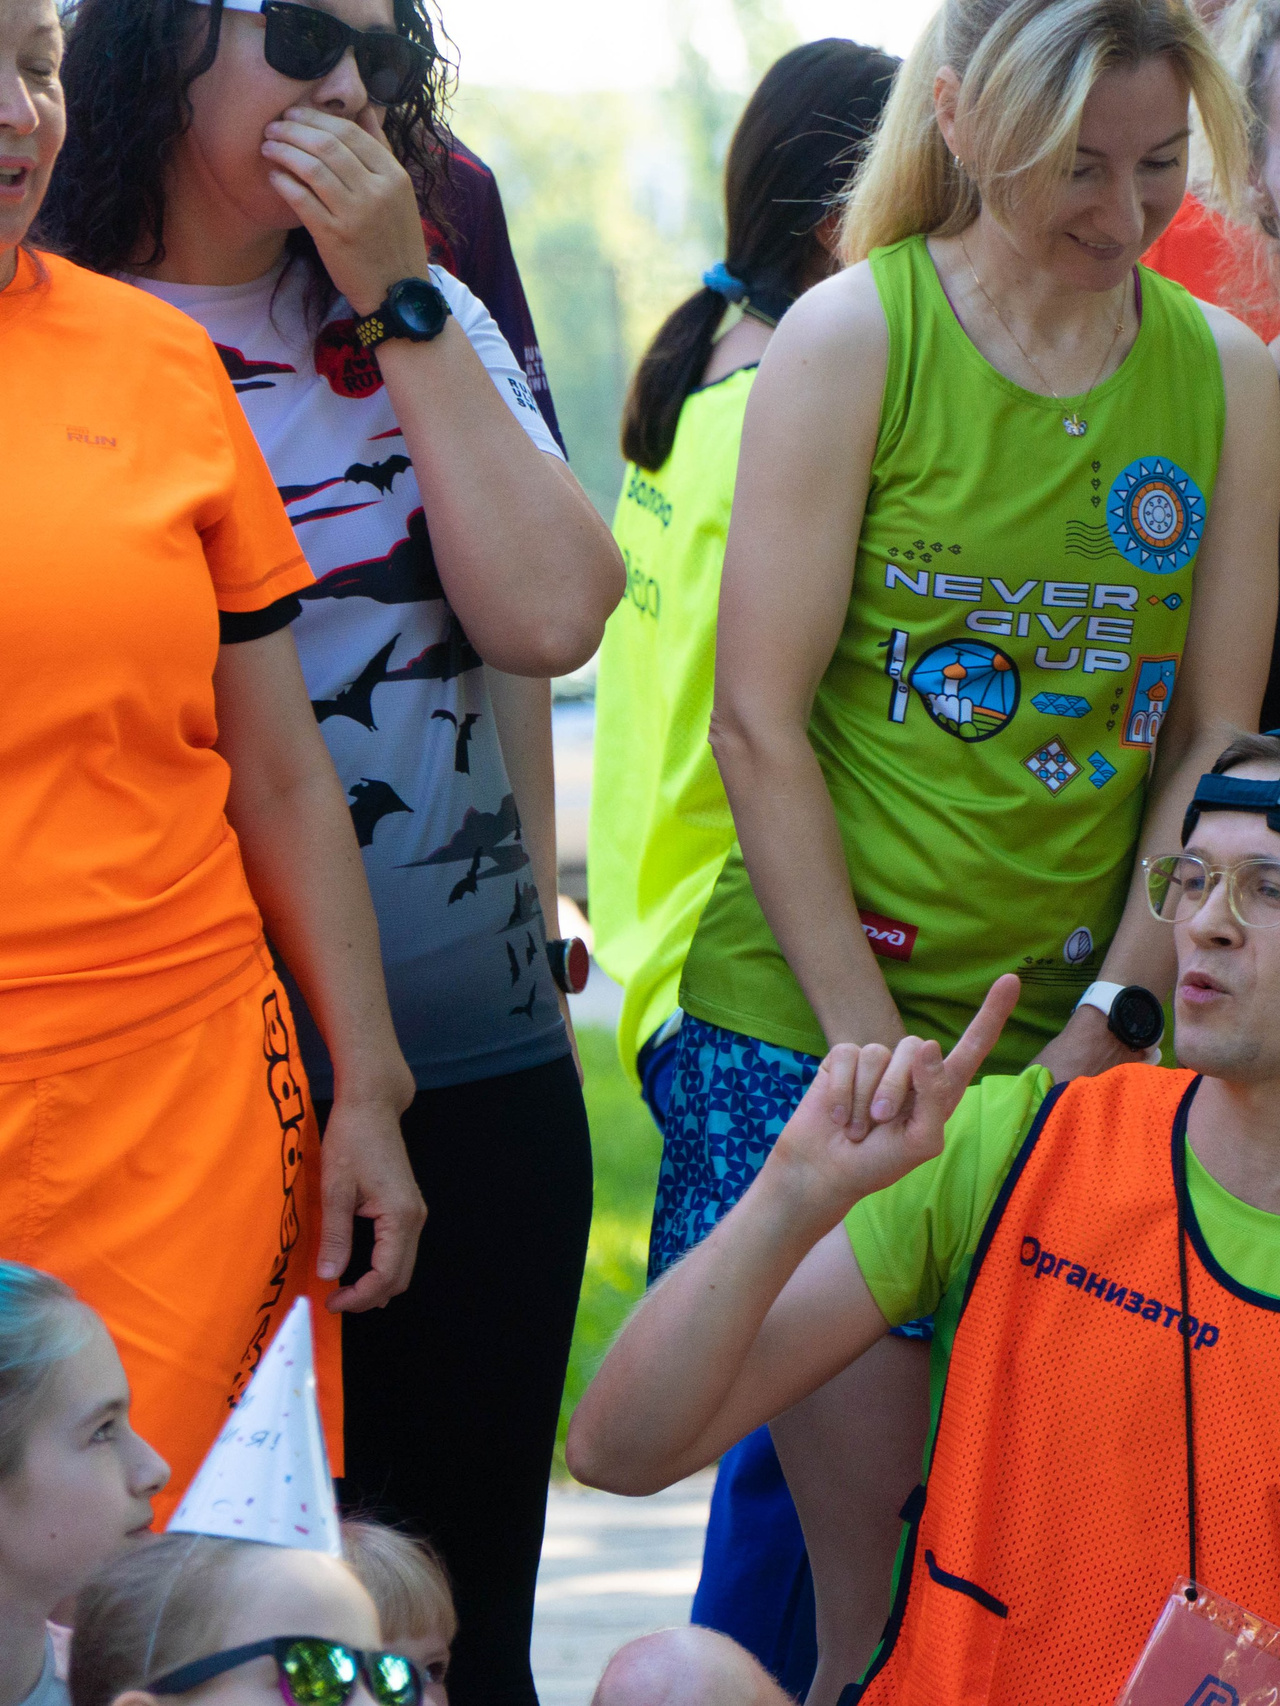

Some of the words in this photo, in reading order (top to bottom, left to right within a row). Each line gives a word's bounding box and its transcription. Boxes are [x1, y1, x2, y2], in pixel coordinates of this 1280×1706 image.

[885, 563, 1139, 612] NEVER
[965, 609, 1134, 645] GIVE
[1034, 645, 1131, 674] UP
[1020, 1236, 1220, 1350] Организатор
